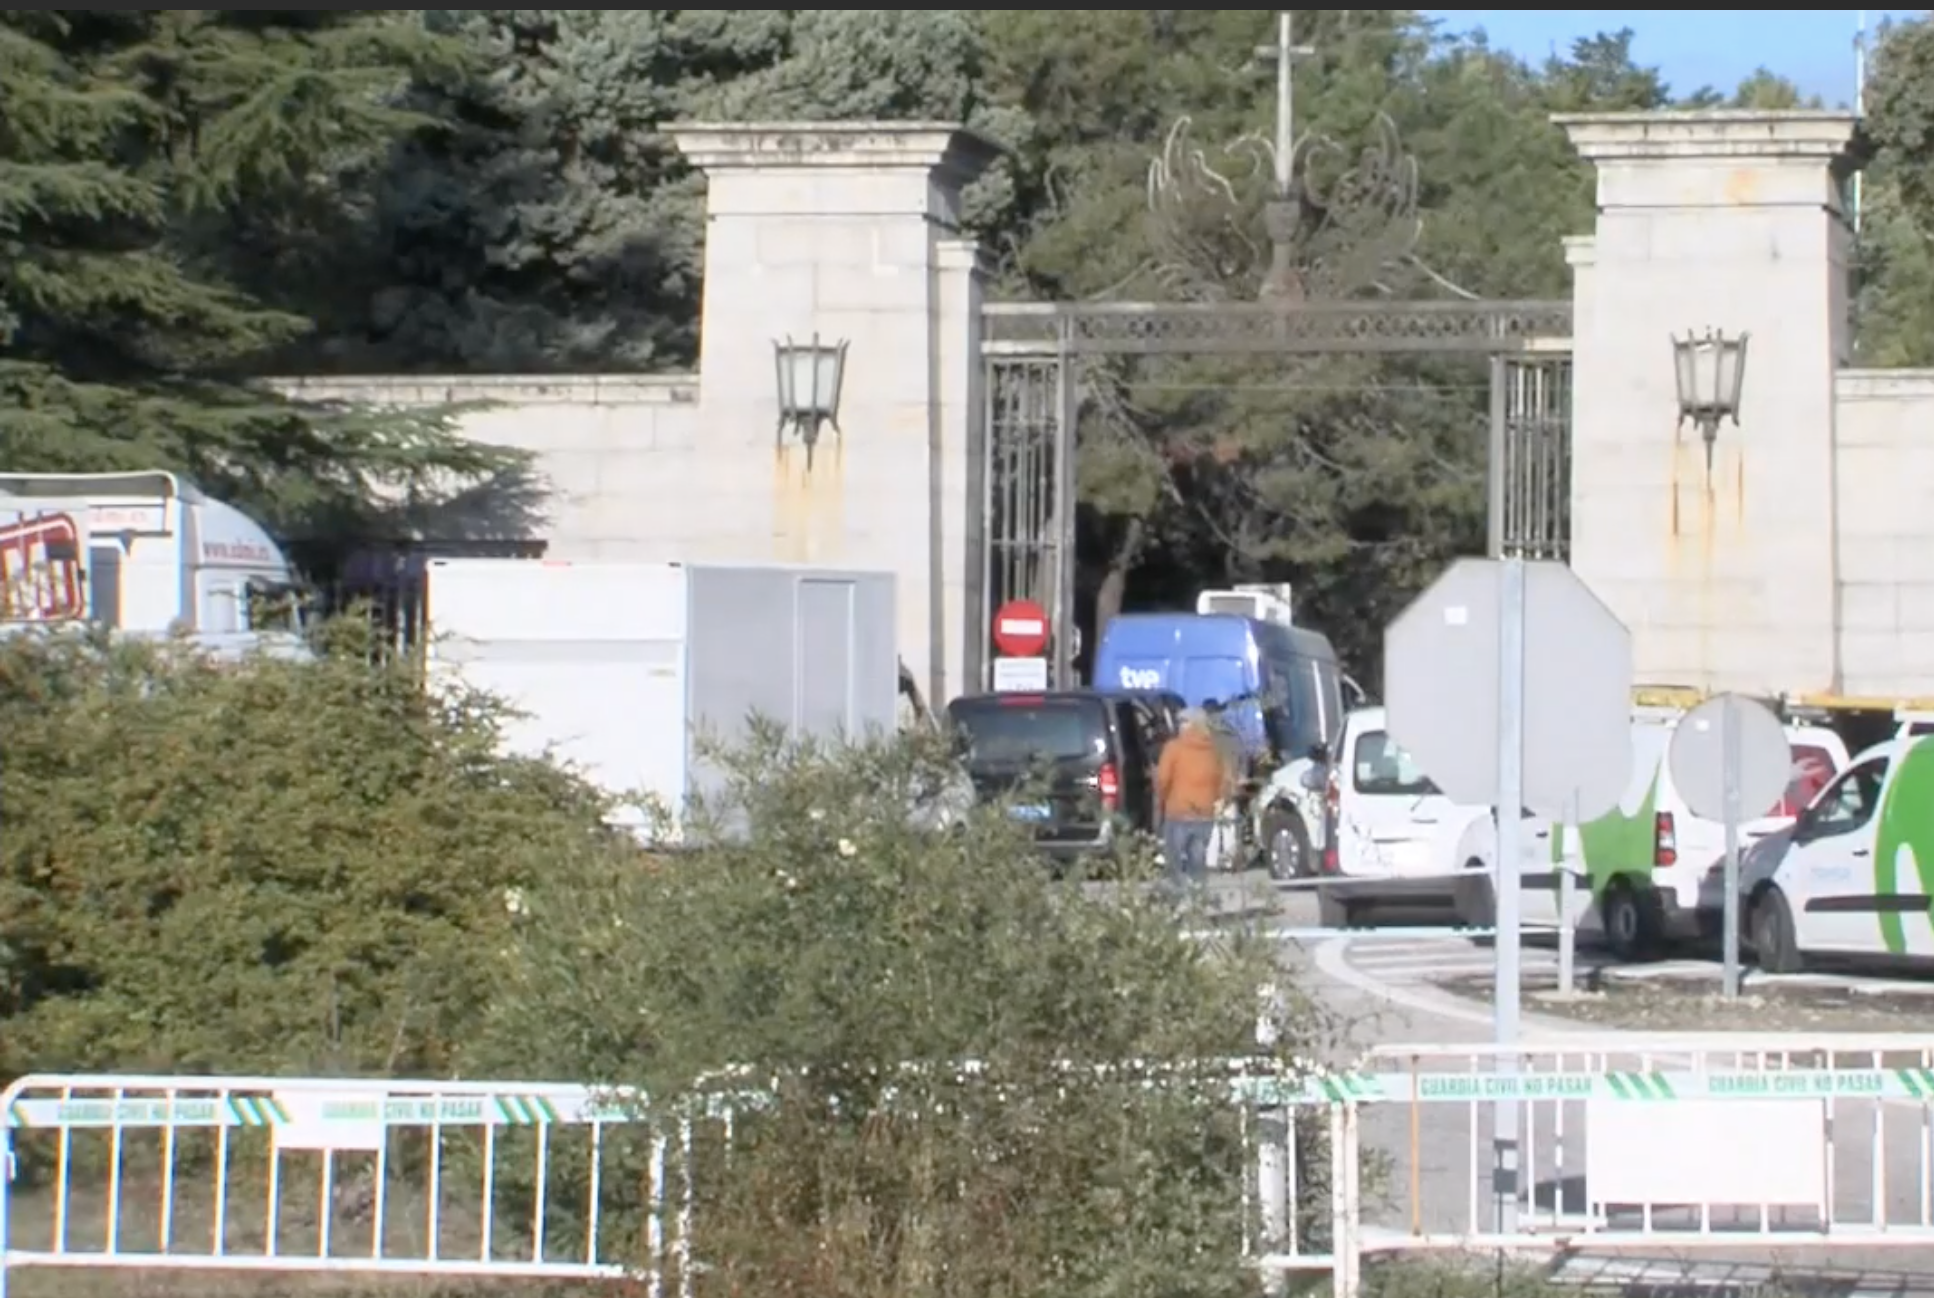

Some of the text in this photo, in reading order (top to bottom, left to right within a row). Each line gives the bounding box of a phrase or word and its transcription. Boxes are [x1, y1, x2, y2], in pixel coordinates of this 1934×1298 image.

[1421, 1077, 1593, 1096] GUARDIA CIVIL NO PASAR
[1709, 1075, 1768, 1092] GUARDIA
[1814, 1075, 1832, 1091] NO
[1838, 1074, 1883, 1091] PASAR
[441, 1101, 483, 1118] PASAR
